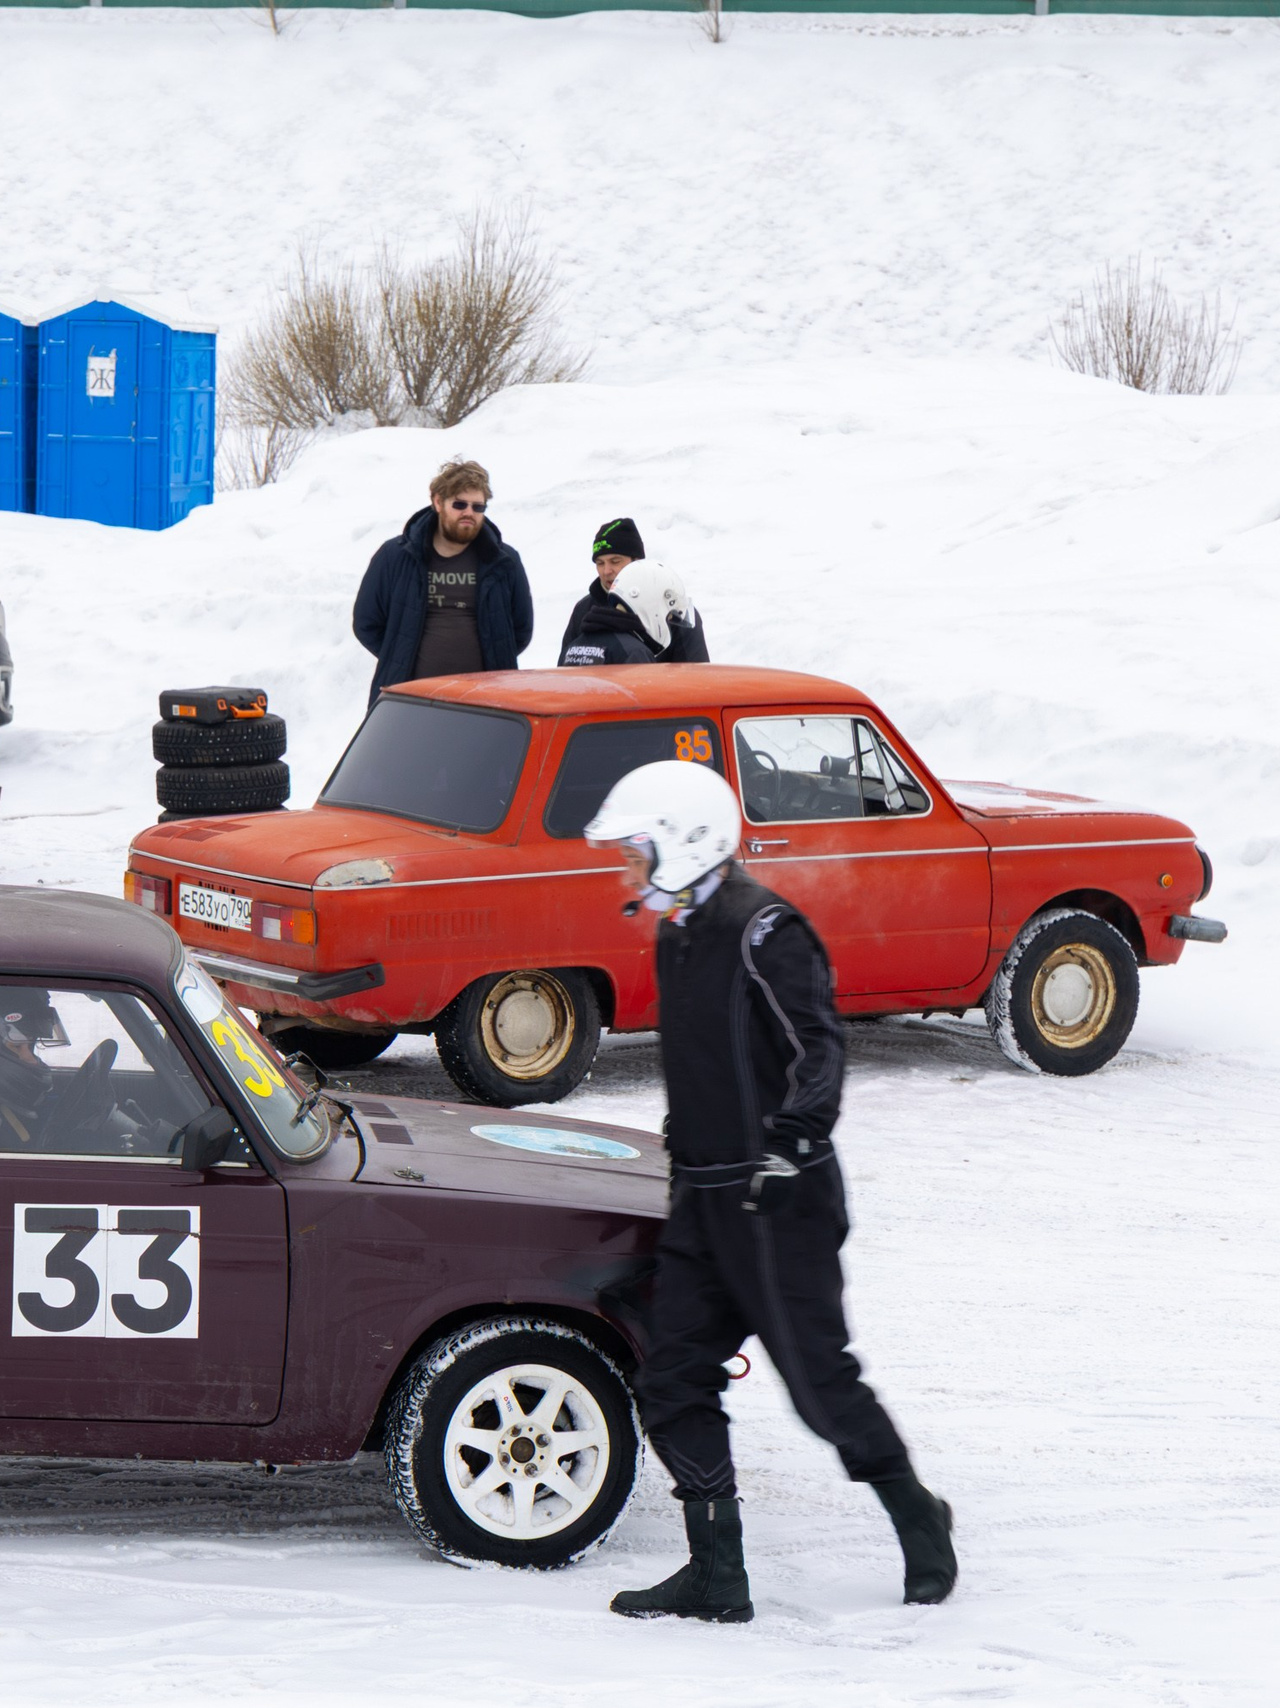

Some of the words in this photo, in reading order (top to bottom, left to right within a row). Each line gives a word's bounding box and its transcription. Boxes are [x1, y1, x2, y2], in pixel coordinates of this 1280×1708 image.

[89, 368, 115, 390] Ж
[674, 729, 712, 762] 85
[230, 897, 250, 919] 790
[17, 1207, 193, 1334] 33
